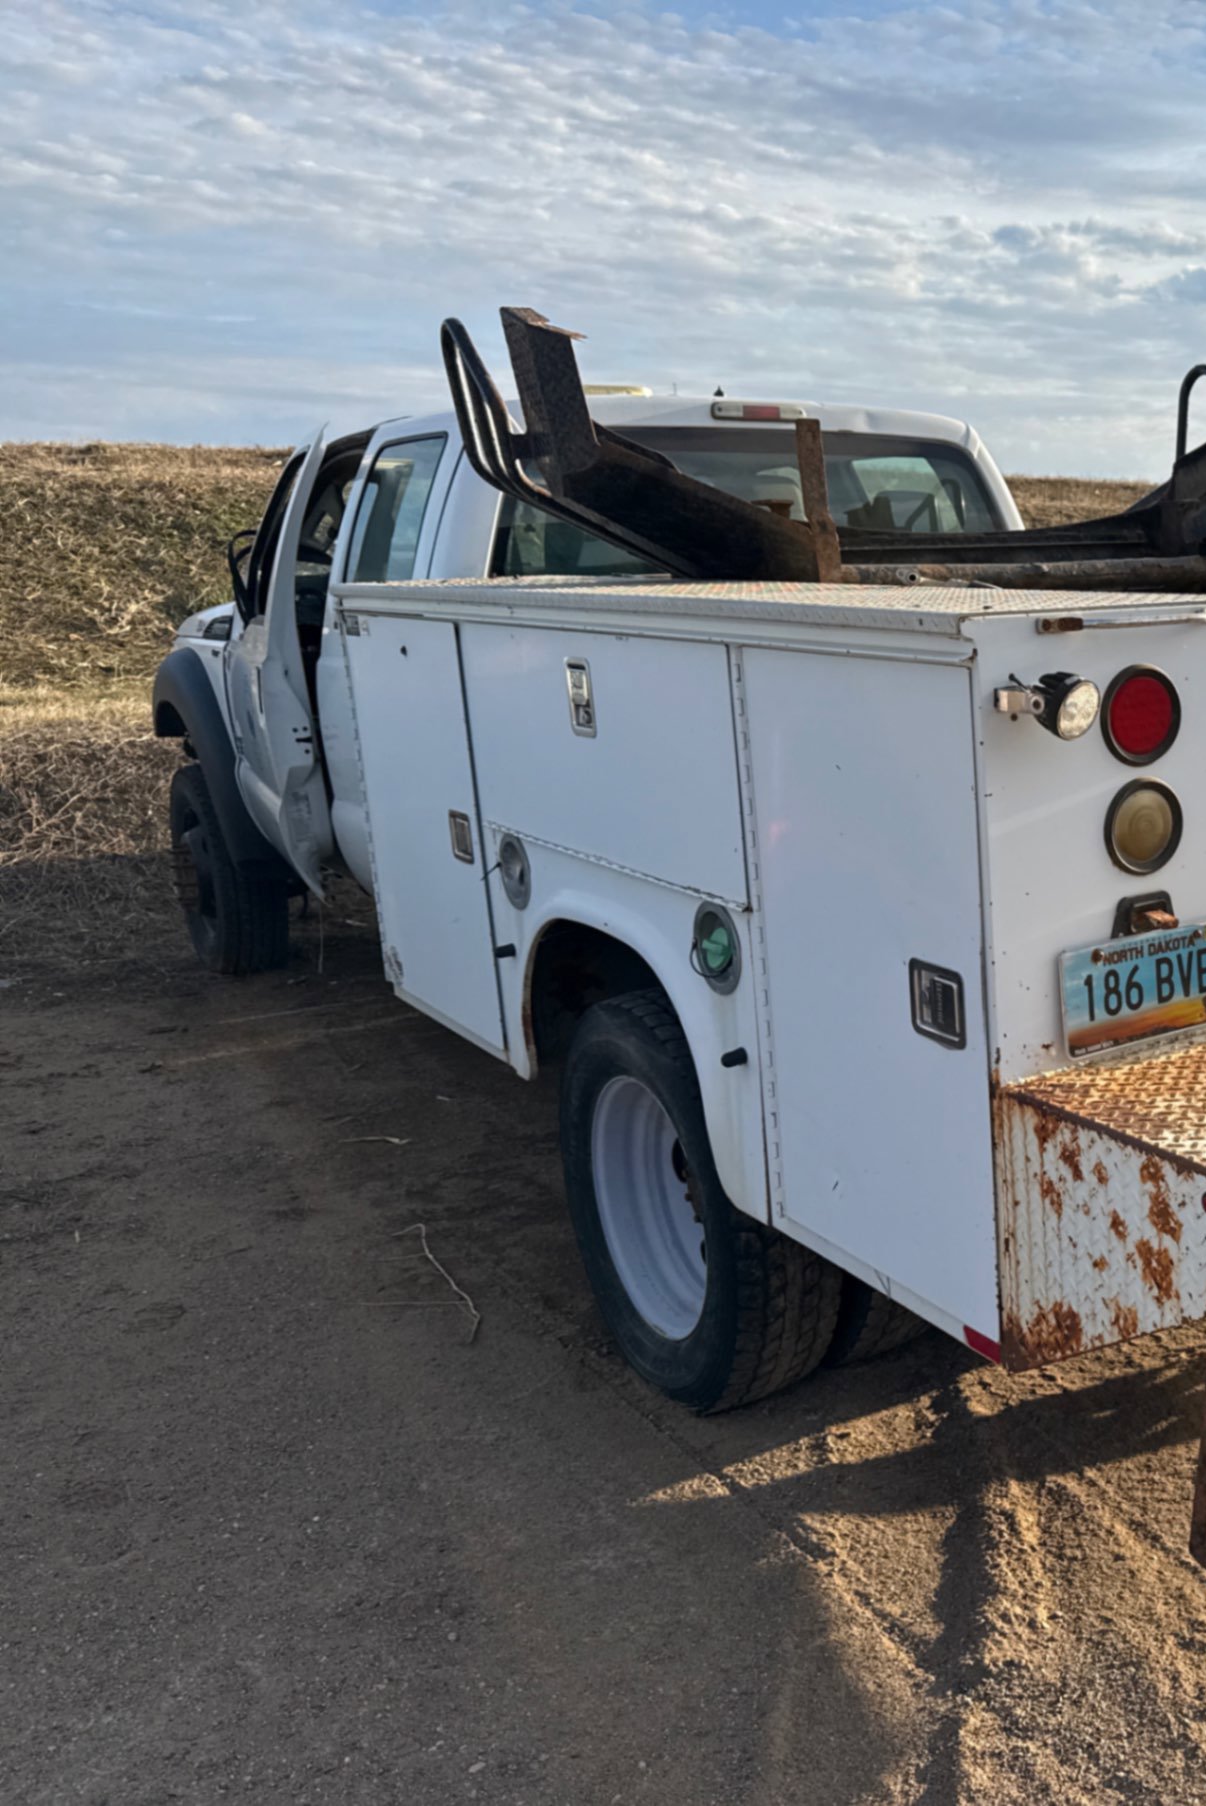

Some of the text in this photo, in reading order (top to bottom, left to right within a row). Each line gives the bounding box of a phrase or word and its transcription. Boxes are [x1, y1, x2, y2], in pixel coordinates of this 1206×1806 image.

[1103, 945, 1144, 966] NORTH
[1149, 935, 1196, 957] DAKOTA
[1084, 965, 1144, 1022] 186
